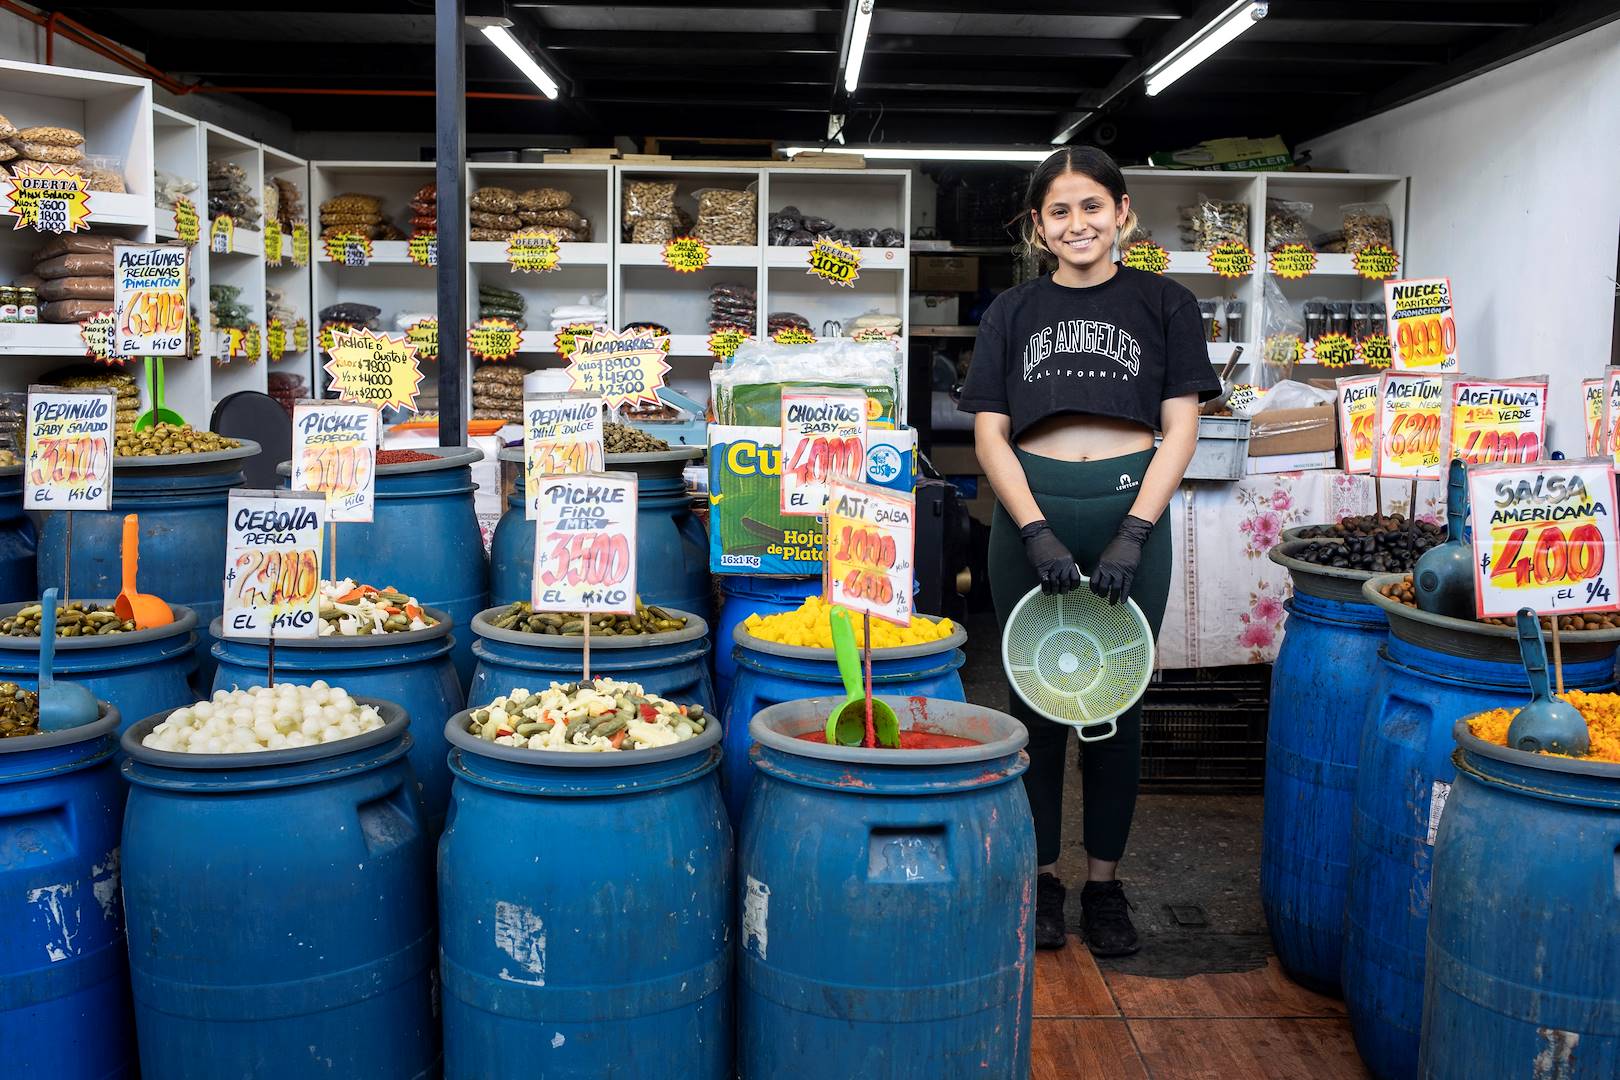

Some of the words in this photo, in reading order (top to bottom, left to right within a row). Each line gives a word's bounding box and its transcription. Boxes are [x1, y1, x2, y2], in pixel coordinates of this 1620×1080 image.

[1228, 155, 1287, 170] SEALER
[22, 178, 78, 190] OFERTA
[515, 238, 552, 248] OFERTA
[119, 249, 185, 268] ACEITUNAS
[820, 244, 855, 261] OFERTA
[122, 267, 180, 279] RELLENAS
[1392, 284, 1447, 300] NUECES
[1396, 296, 1450, 309] MARIPOSAS
[122, 340, 140, 351] EL
[581, 338, 655, 355] ALCAPARRAS
[1023, 326, 1053, 381] LOS
[1054, 320, 1141, 377] ANGELES
[1027, 369, 1129, 383] CALIFORNIA
[1457, 388, 1539, 407] ACEITUNA
[1498, 409, 1532, 421] VERDE
[33, 423, 65, 437] BABY
[66, 421, 109, 434] SALADO
[298, 412, 369, 435] PICKLE
[561, 421, 594, 435] DULCE
[800, 422, 839, 435] BABY
[305, 432, 368, 445] ESPECIAL
[34, 489, 54, 502] EL
[544, 483, 626, 505] PICKLE
[1493, 472, 1588, 508] SALSA
[790, 493, 809, 506] EL
[559, 506, 606, 519] FINO
[874, 508, 910, 523] SALSA
[1490, 502, 1607, 524] AMERICANA
[243, 532, 297, 545] PERLA
[767, 543, 783, 555] de
[542, 590, 567, 603] EL
[1557, 588, 1576, 600] EL
[1586, 577, 1611, 604] 1/4
[233, 614, 257, 630] EL
